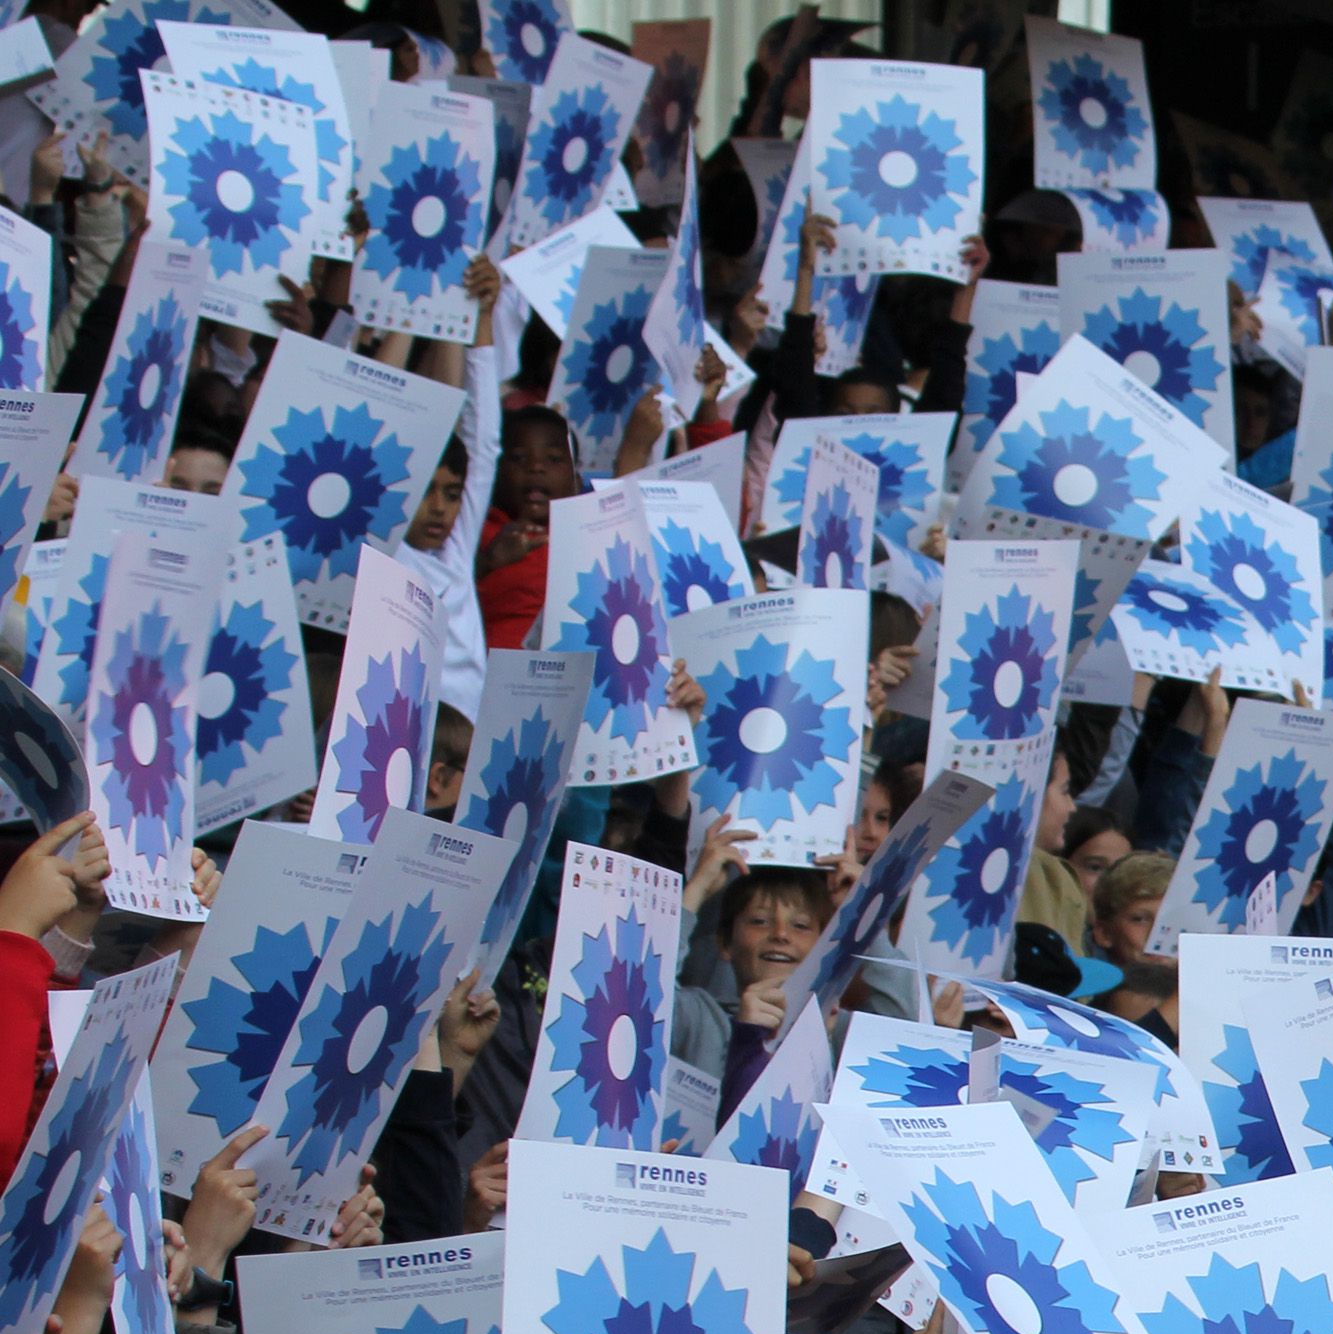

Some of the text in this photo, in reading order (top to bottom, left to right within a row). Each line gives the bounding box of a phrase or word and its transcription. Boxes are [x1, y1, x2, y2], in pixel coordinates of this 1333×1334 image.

[361, 365, 405, 387] rennes
[152, 495, 187, 507] rennes
[1005, 548, 1038, 557] rennes
[743, 597, 794, 611] rennes
[537, 660, 565, 672] rennes
[1292, 712, 1325, 726] rennes
[440, 835, 474, 856] rennes
[684, 1072, 717, 1096] rennes
[888, 1118, 947, 1132] rennes
[640, 1166, 707, 1185] rennes
[1175, 1197, 1244, 1220] rennes
[386, 1248, 471, 1268] rennes
